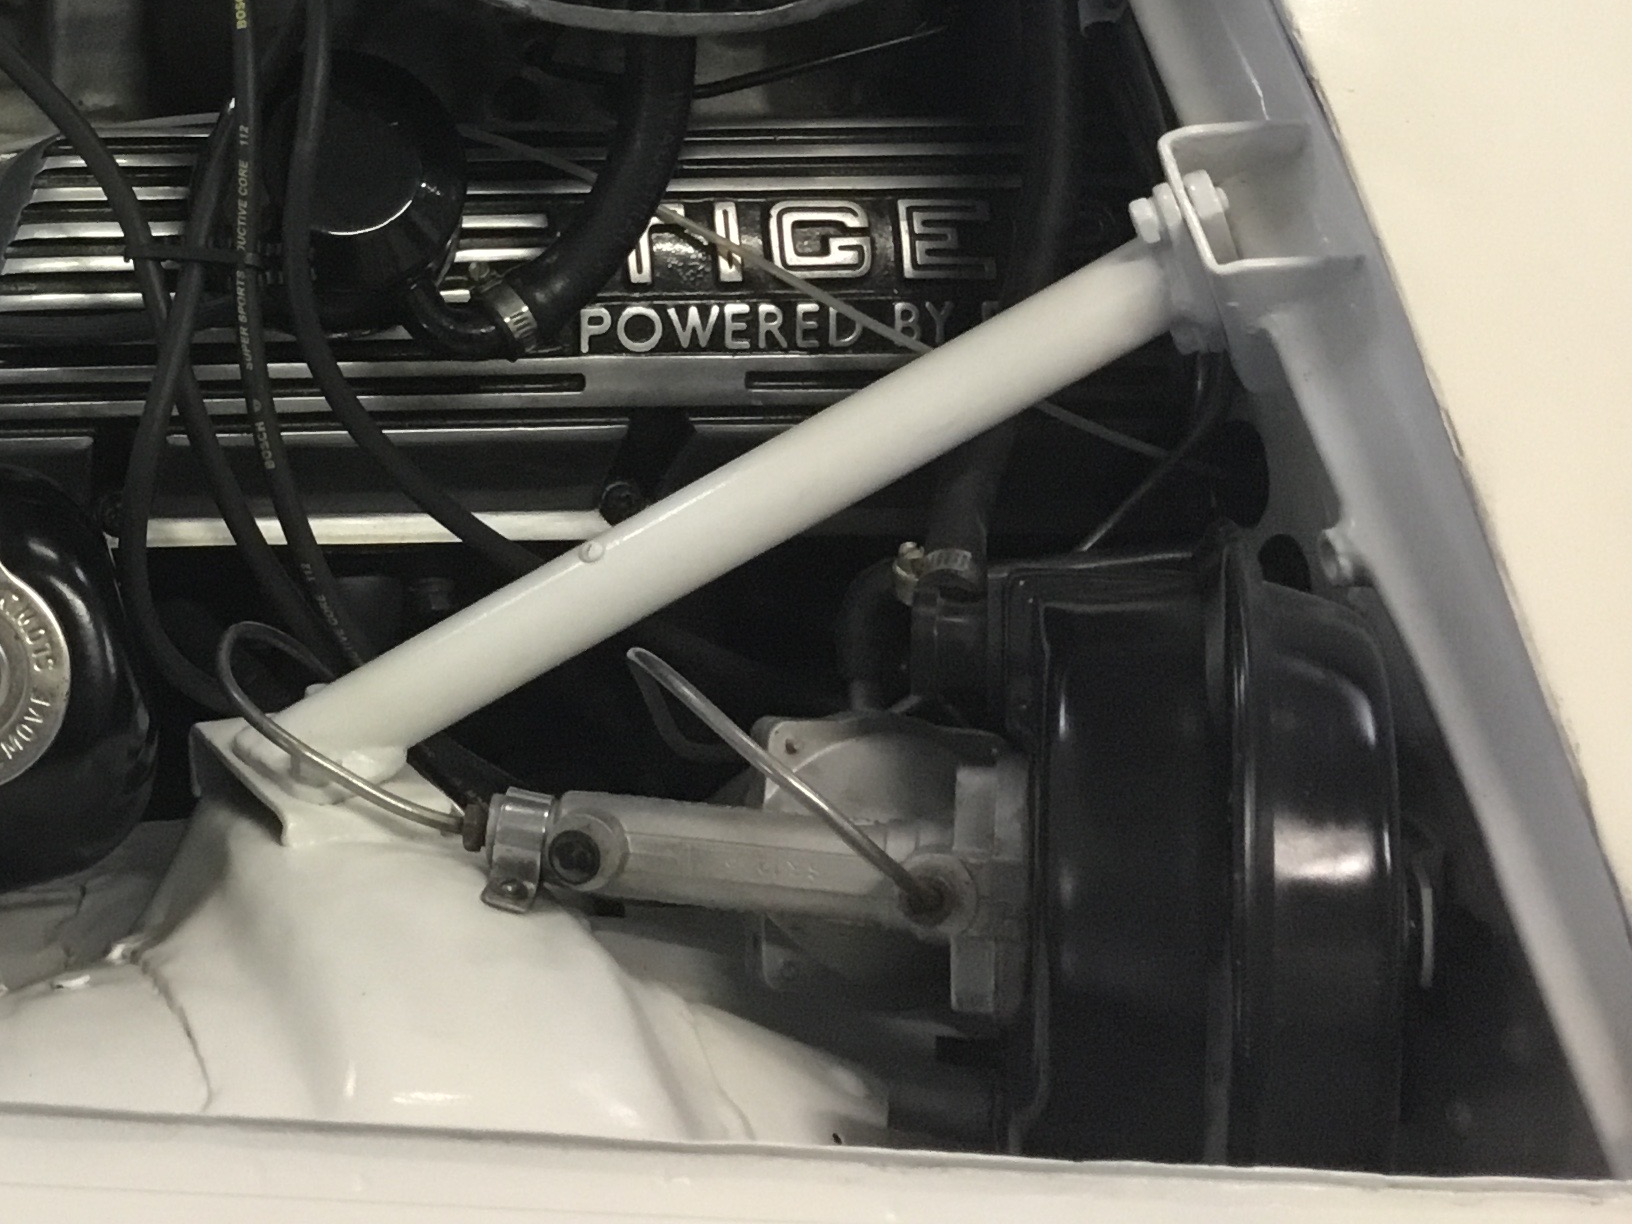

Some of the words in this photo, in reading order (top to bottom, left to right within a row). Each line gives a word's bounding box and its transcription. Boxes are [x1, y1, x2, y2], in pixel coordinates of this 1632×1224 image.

[239, 124, 249, 146] 112
[237, 159, 249, 196] CORE
[236, 270, 248, 323] SPORTS
[239, 326, 254, 371] SUPER
[579, 303, 864, 354] POWERED
[893, 299, 955, 346] BY
[255, 421, 276, 469] BOSCH
